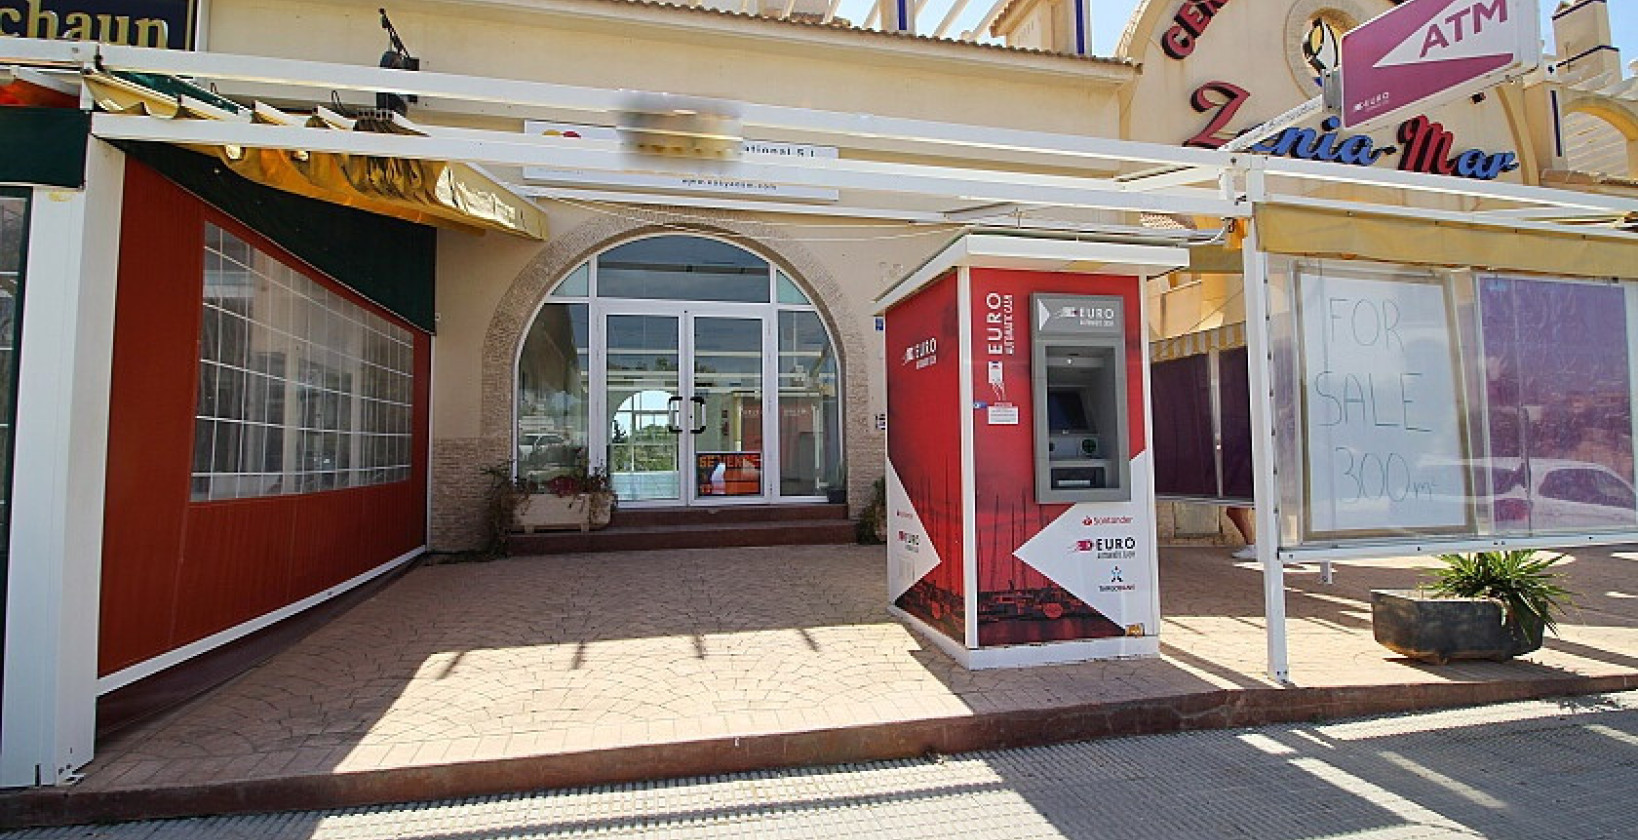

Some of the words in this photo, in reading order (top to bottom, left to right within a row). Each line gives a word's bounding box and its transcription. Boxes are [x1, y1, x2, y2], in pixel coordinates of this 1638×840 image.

[1420, 0, 1508, 58] ATM
[1182, 80, 1396, 167] Znia
[1396, 114, 1519, 180] Mar
[986, 292, 1003, 355] EURO
[1079, 308, 1115, 320] EURO
[1329, 297, 1404, 352] FOR
[915, 337, 937, 359] EURO
[1314, 370, 1432, 433] SALE
[1096, 537, 1136, 551] EURO
